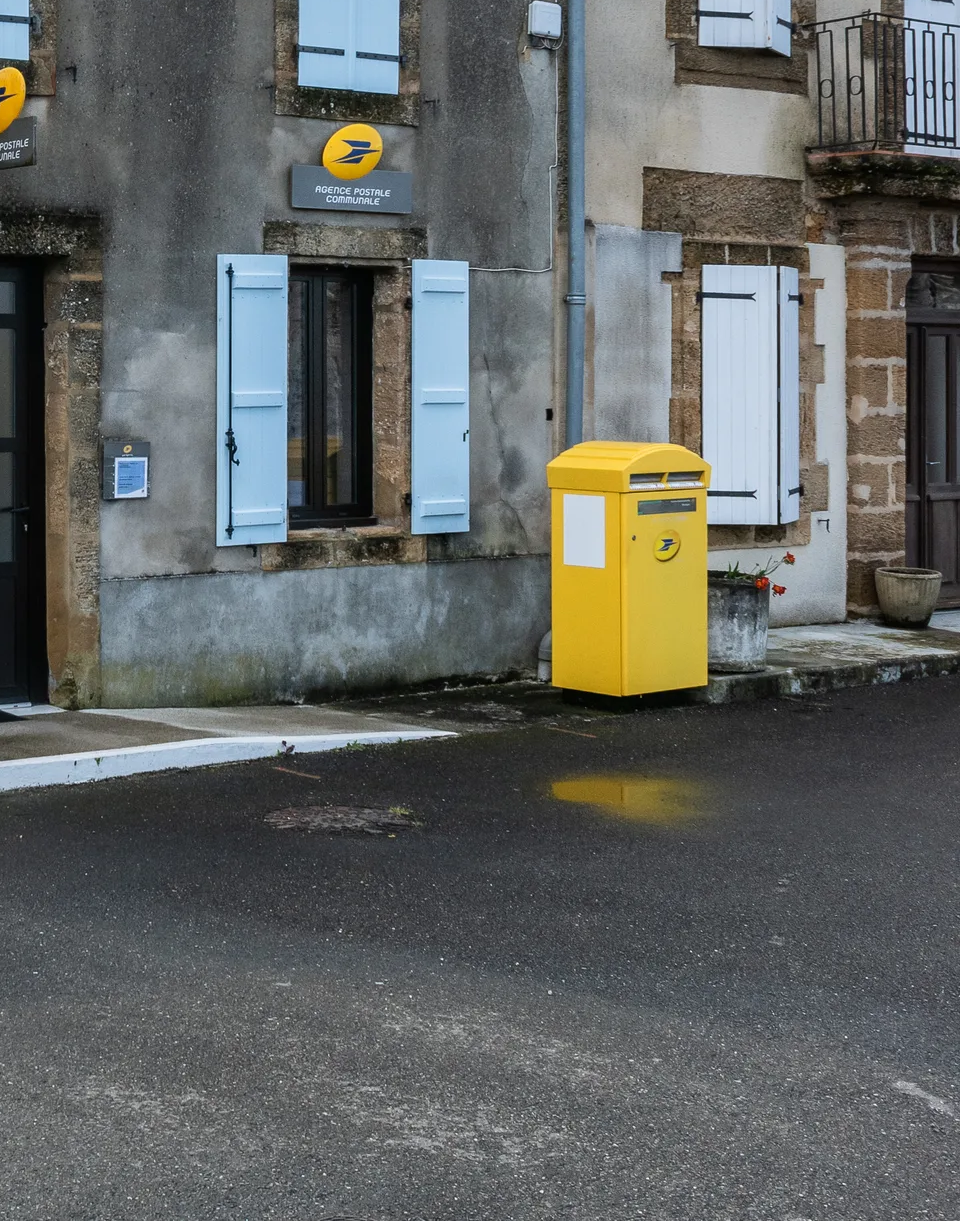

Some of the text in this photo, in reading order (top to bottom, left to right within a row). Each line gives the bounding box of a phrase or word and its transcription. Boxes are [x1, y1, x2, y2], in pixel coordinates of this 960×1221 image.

[0, 138, 29, 151] POSTALE
[315, 185, 391, 197] AGENCE POSTALE
[326, 195, 381, 206] COMMUNALE
